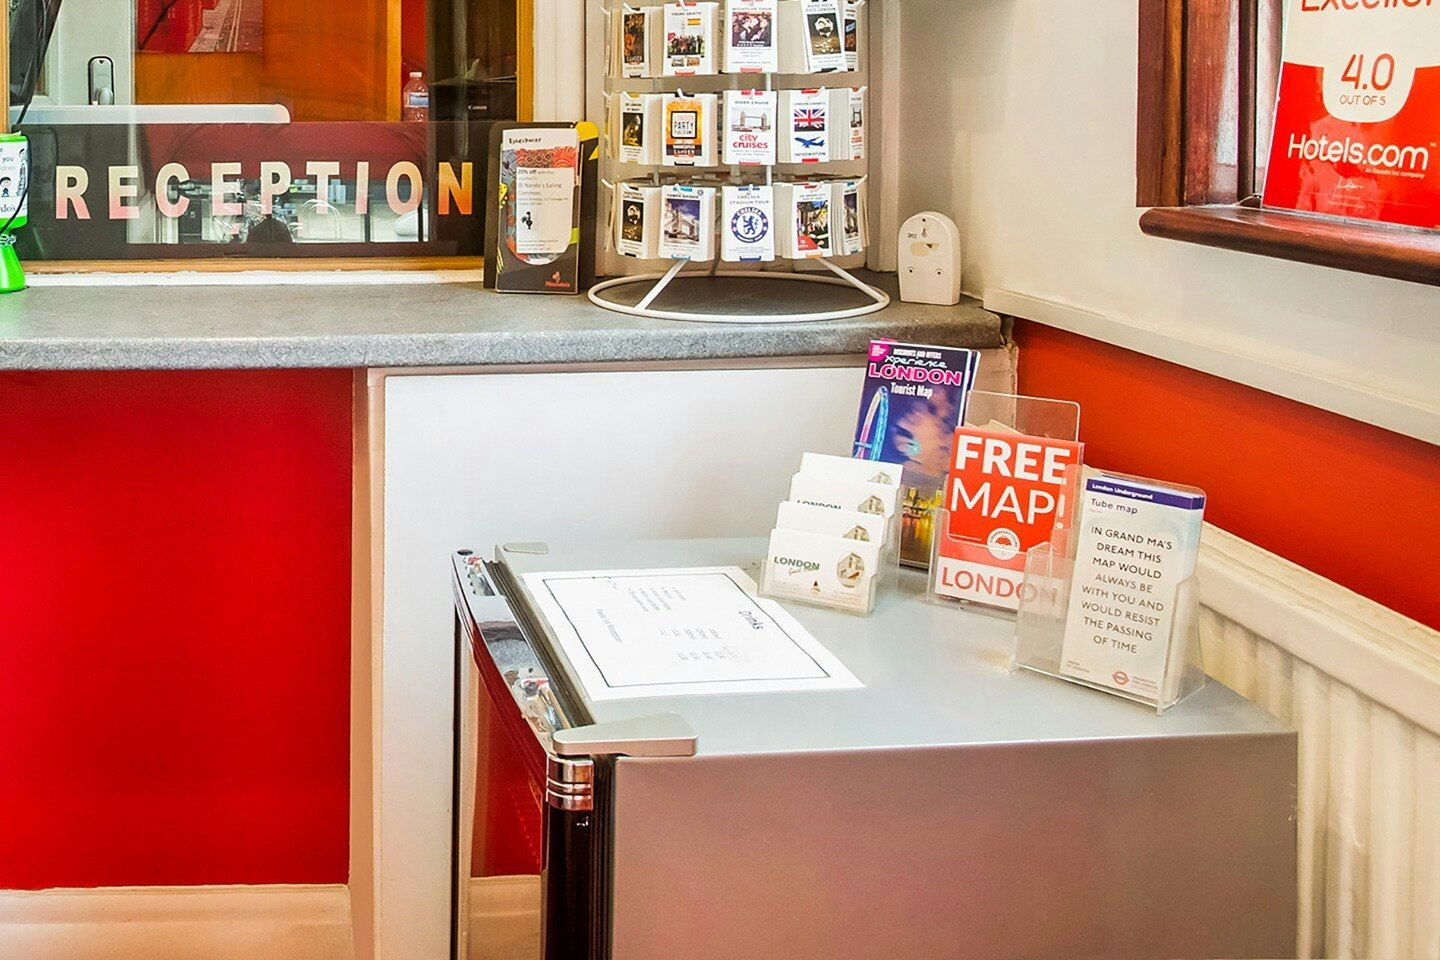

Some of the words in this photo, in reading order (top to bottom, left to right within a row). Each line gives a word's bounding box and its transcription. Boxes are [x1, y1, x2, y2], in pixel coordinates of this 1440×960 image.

[1341, 53, 1395, 91] 4.0
[1339, 95, 1362, 106] OUT
[1364, 95, 1377, 105] OF
[1380, 95, 1386, 105] 5
[1288, 133, 1430, 170] Hotels.com
[55, 161, 474, 220] RECEPTION
[869, 363, 962, 386] LONDON
[891, 382, 916, 395] Tourist
[917, 385, 933, 399] Map
[955, 434, 1070, 485] FREE
[951, 478, 1065, 529] MAP!
[1092, 484, 1113, 492] London
[1115, 488, 1153, 500] Underground
[1091, 498, 1113, 509] Tube
[1116, 504, 1138, 515] map
[1092, 526, 1102, 535] IN
[1105, 528, 1143, 543] GRAND
[1147, 538, 1173, 550] MA'S
[774, 557, 820, 570] LONDON
[1096, 542, 1134, 557] DREAM
[1138, 551, 1161, 563] THIS
[1093, 557, 1115, 568] MAP
[1119, 563, 1162, 579] WOULD
[941, 566, 1057, 608] LONDON
[1095, 573, 1136, 589] ALWAYS
[1140, 583, 1153, 593] BE
[1082, 585, 1109, 598] WITH
[1112, 592, 1136, 605] YOU
[1139, 599, 1164, 611] AND
[1081, 601, 1122, 617] WOULD
[1125, 612, 1160, 626] RESIST
[1084, 617, 1103, 629] THE
[1107, 623, 1152, 641] PASSING
[1093, 636, 1107, 645] OF
[1111, 640, 1138, 653] TIME
